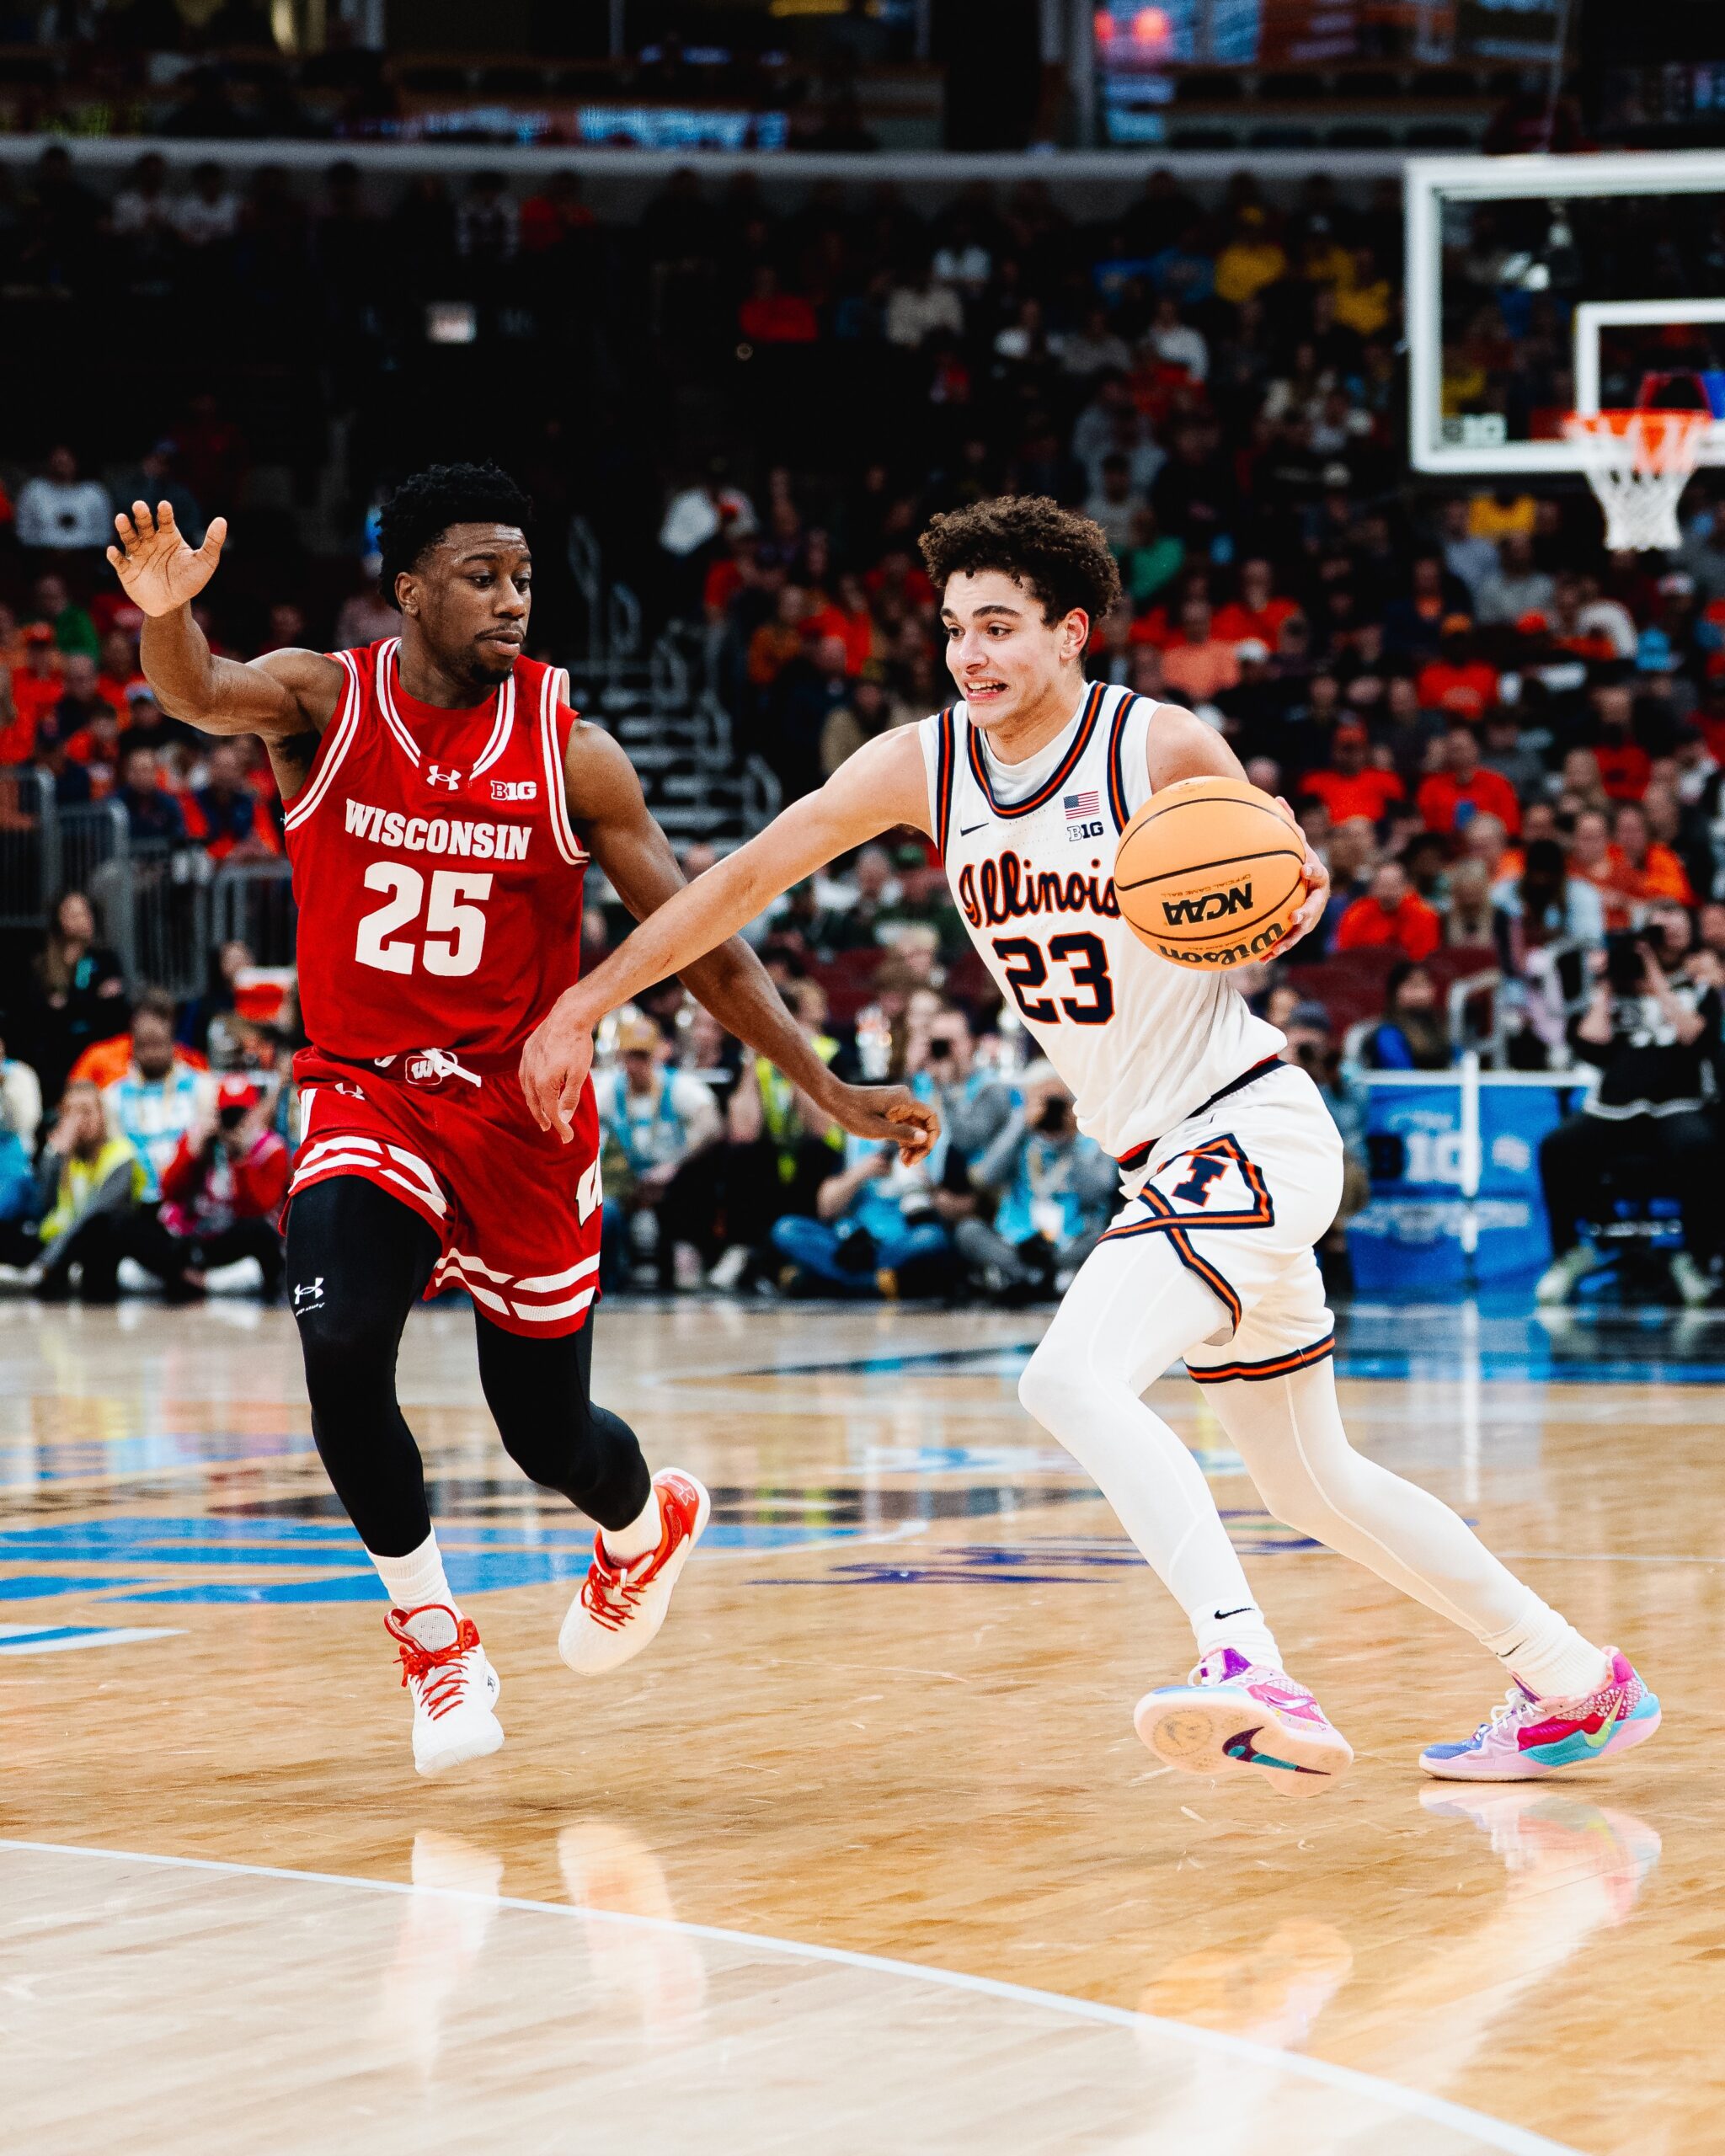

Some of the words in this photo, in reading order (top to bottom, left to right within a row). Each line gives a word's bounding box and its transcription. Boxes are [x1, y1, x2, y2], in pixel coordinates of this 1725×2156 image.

[344, 798, 532, 861] WISCONSIN
[959, 851, 1123, 929] Illinois
[1162, 883, 1253, 926] NCAA
[1214, 873, 1252, 889] OFFICIAL
[355, 861, 494, 977] 25
[991, 931, 1115, 1025] 23
